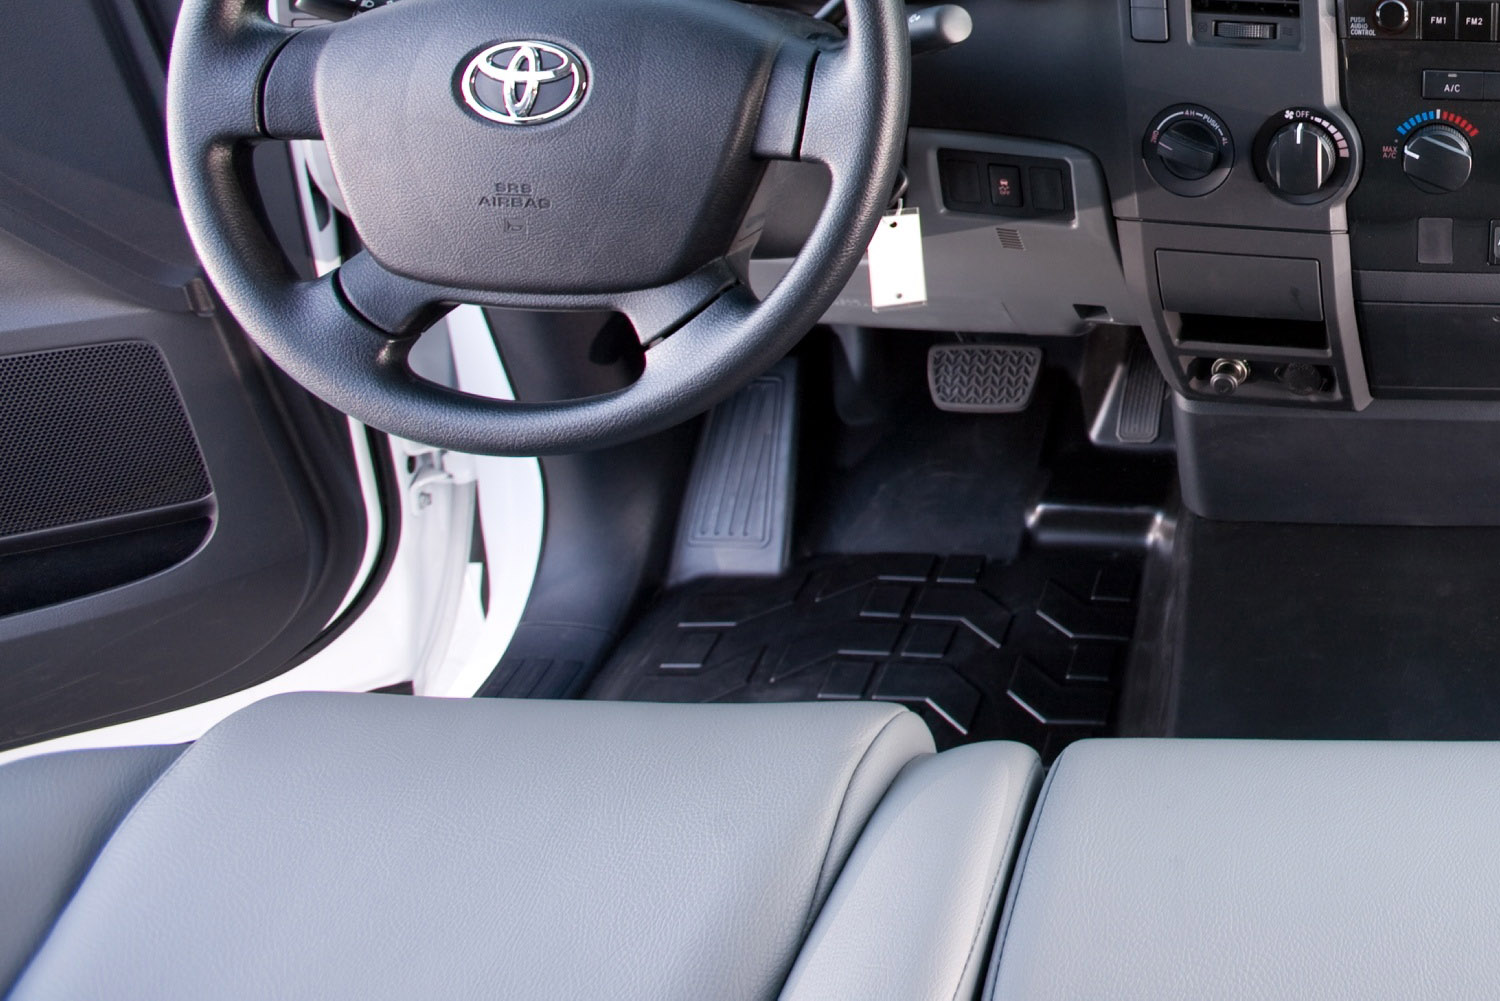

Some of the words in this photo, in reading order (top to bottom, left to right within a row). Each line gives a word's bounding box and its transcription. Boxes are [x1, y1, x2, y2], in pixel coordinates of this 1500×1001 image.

[1430, 16, 1447, 24] FM1
[1466, 17, 1483, 26] FM2
[1443, 84, 1460, 93] A/C
[1295, 110, 1310, 118] OFF
[1202, 113, 1220, 130] PUSH
[478, 196, 553, 210] AIRBAG
